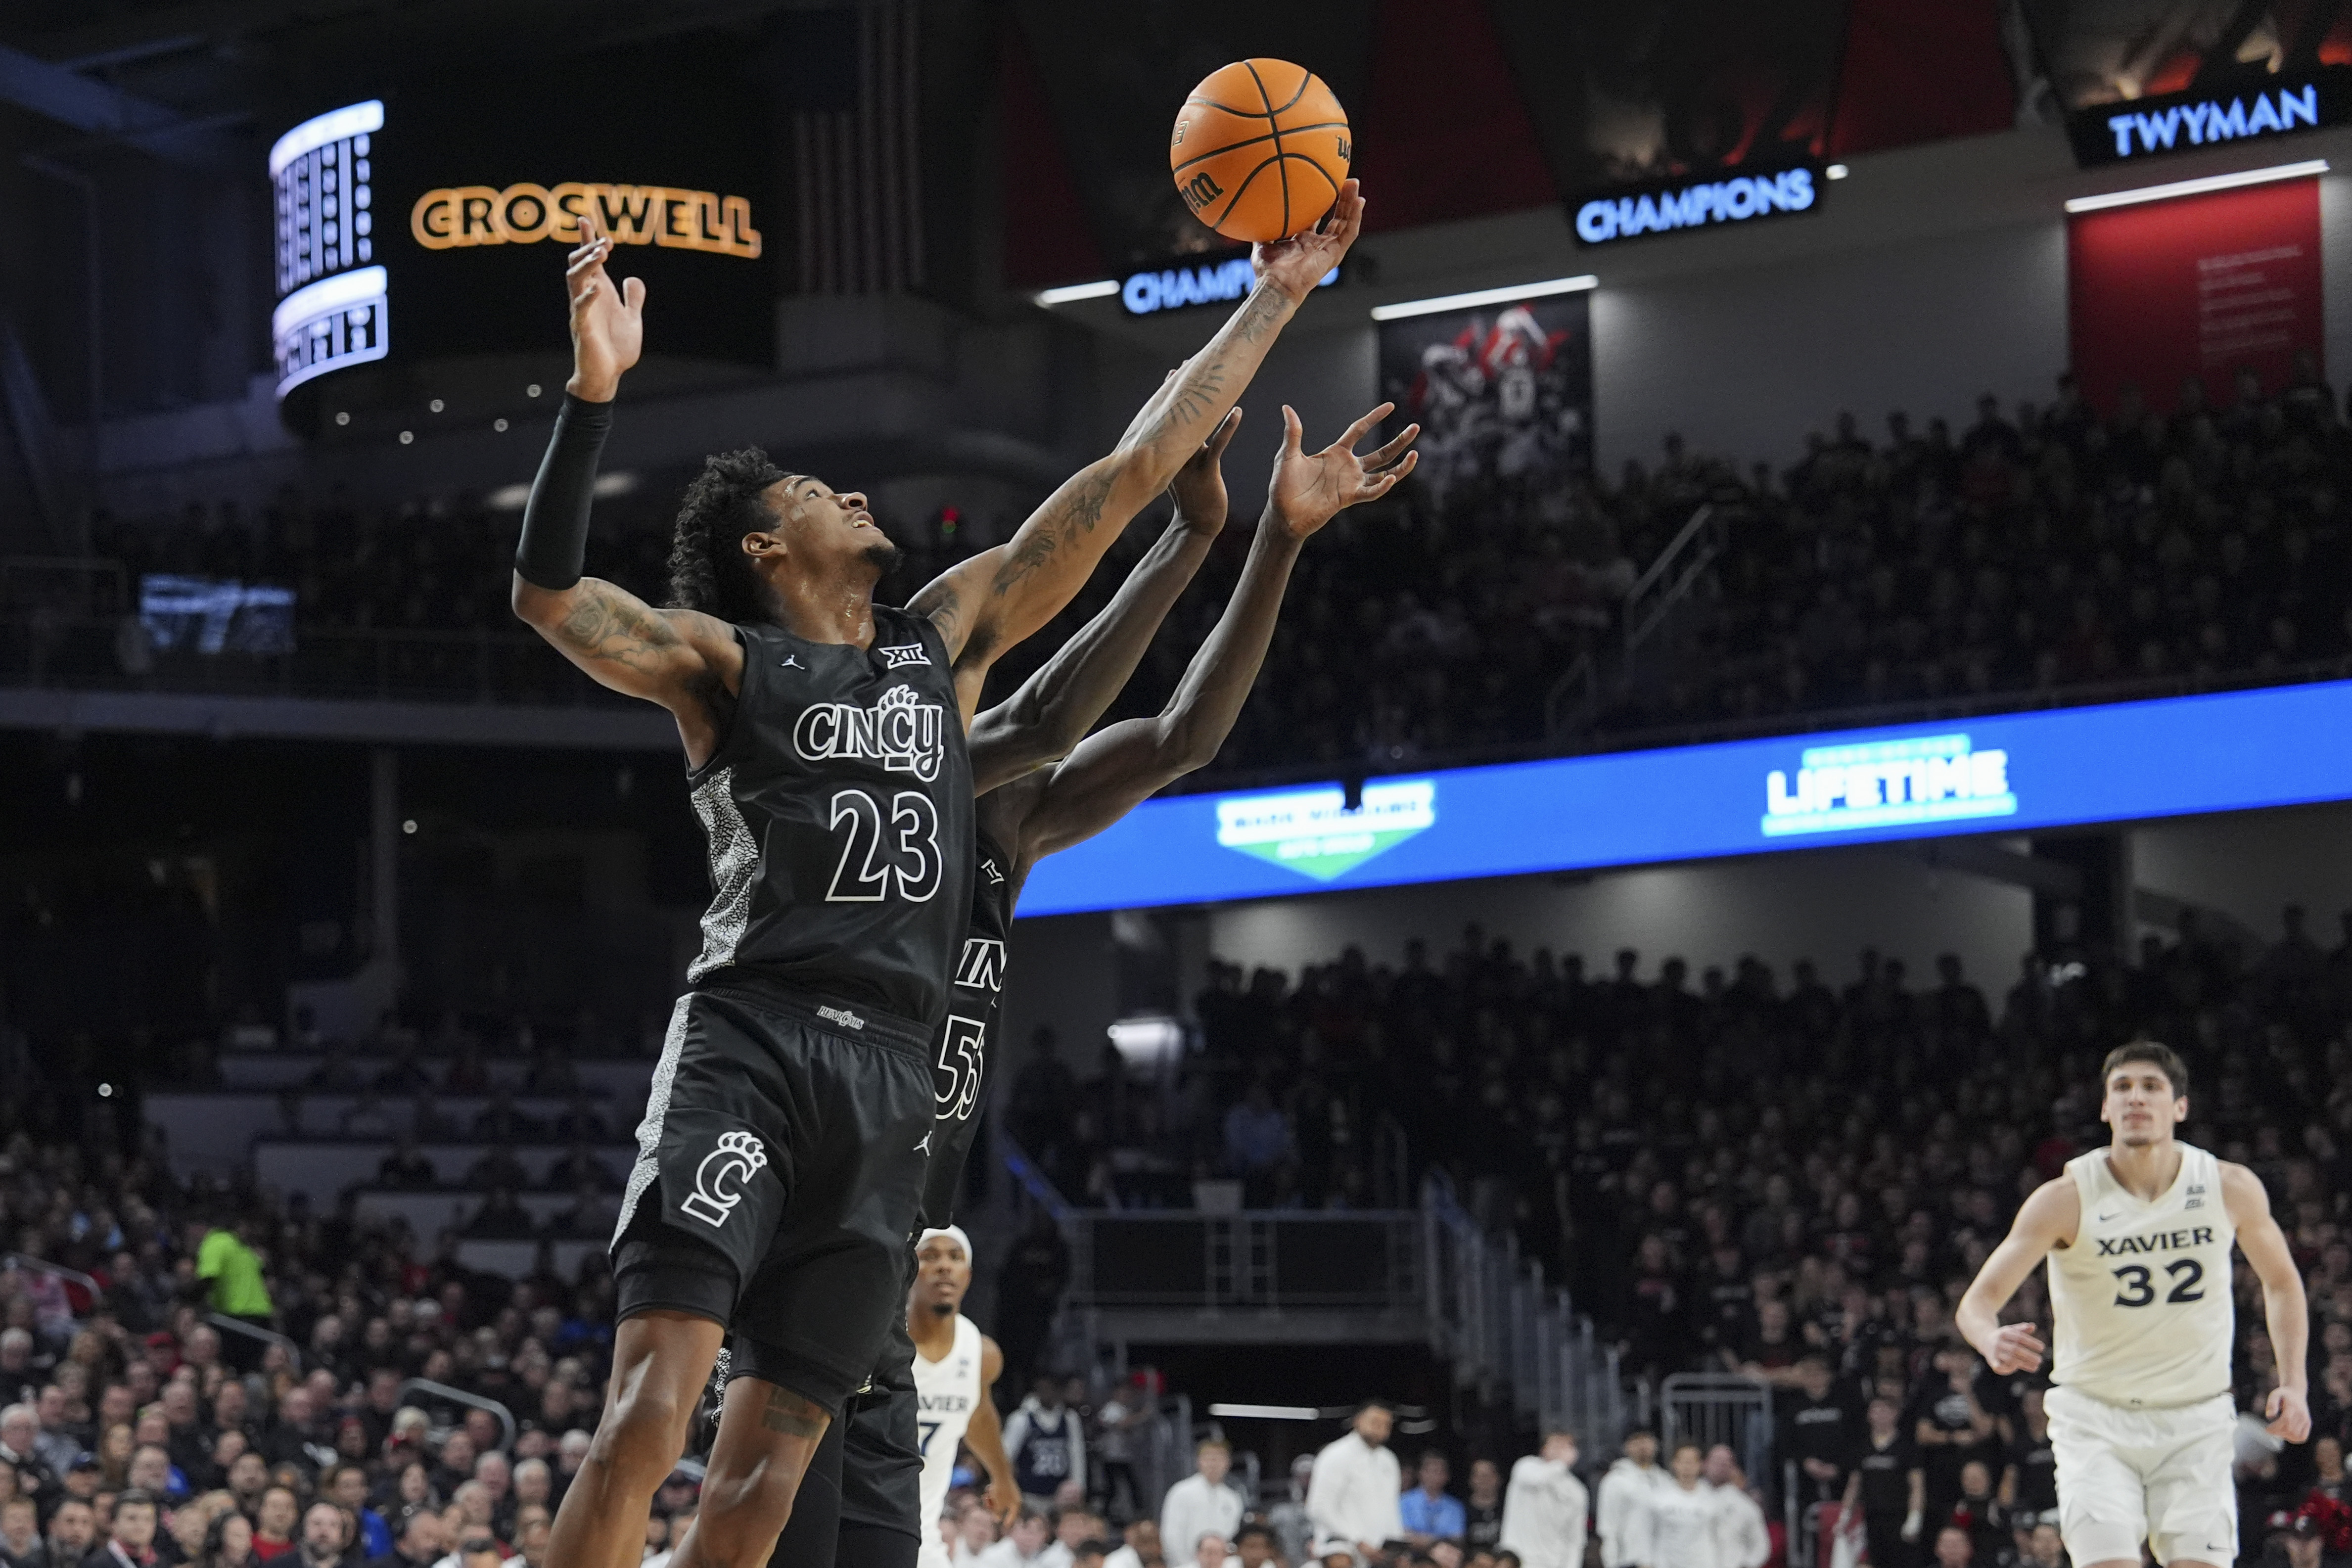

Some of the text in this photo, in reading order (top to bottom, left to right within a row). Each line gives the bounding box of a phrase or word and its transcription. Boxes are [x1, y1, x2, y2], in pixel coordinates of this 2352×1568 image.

[2107, 83, 2318, 157] TWYMAN
[411, 183, 762, 259] CROSWELL
[1576, 167, 1815, 243] CHAMPIONS
[1767, 748, 2009, 815] LIFETIME
[825, 789, 943, 903] 23
[817, 1005, 865, 1030] BEARCATS
[2096, 1225, 2214, 1256] XAVIER
[2110, 1258, 2206, 1308] 32
[919, 1421, 942, 1457] 7
